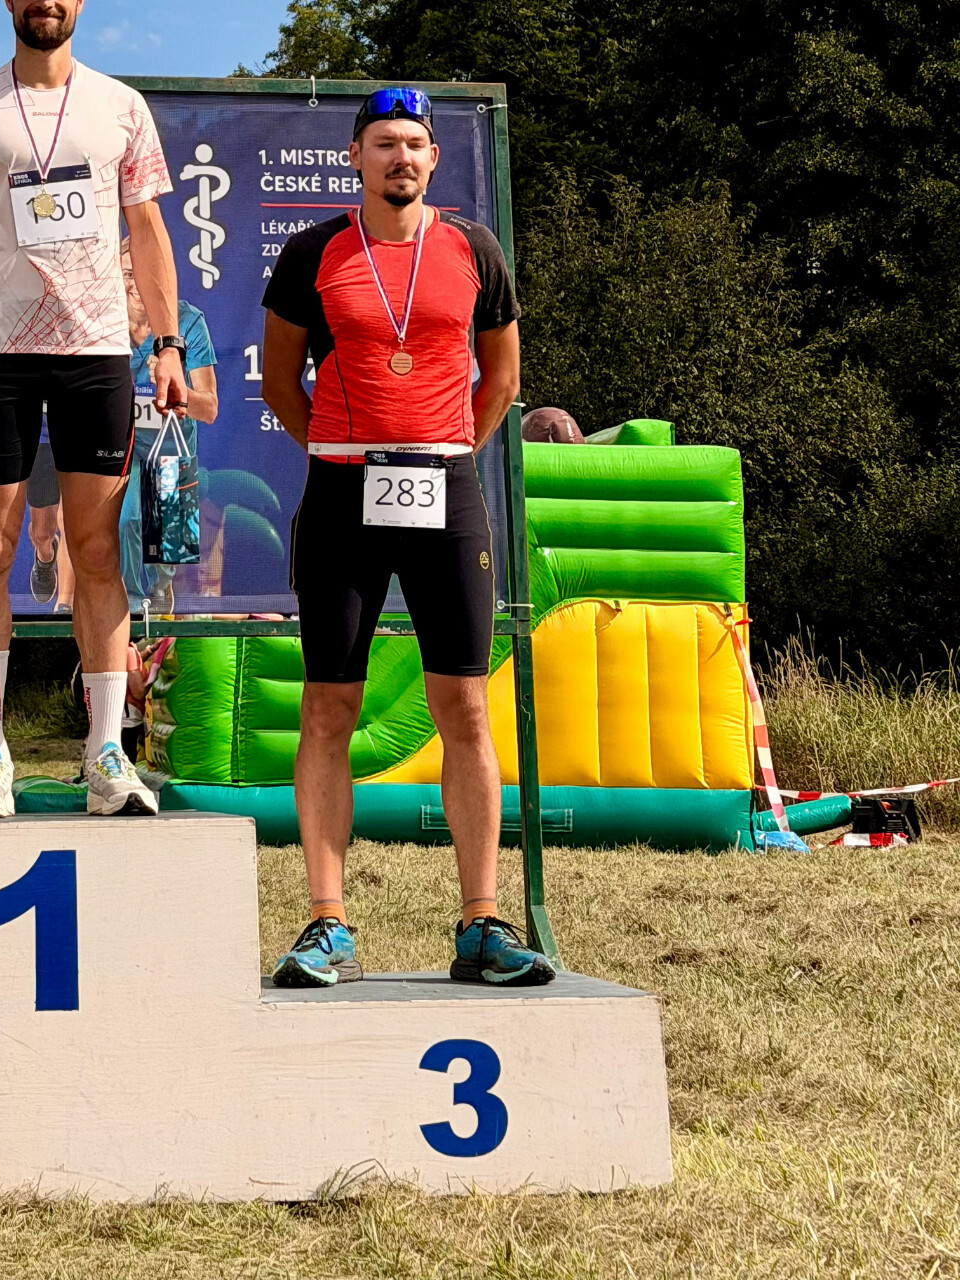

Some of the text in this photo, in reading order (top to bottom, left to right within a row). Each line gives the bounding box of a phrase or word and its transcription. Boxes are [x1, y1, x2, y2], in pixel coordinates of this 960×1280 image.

[258, 149, 274, 166] 1.
[260, 171, 322, 192] ČESKÉ
[261, 243, 285, 257] ZD
[375, 477, 435, 508] 283
[418, 1038, 509, 1158] 3
